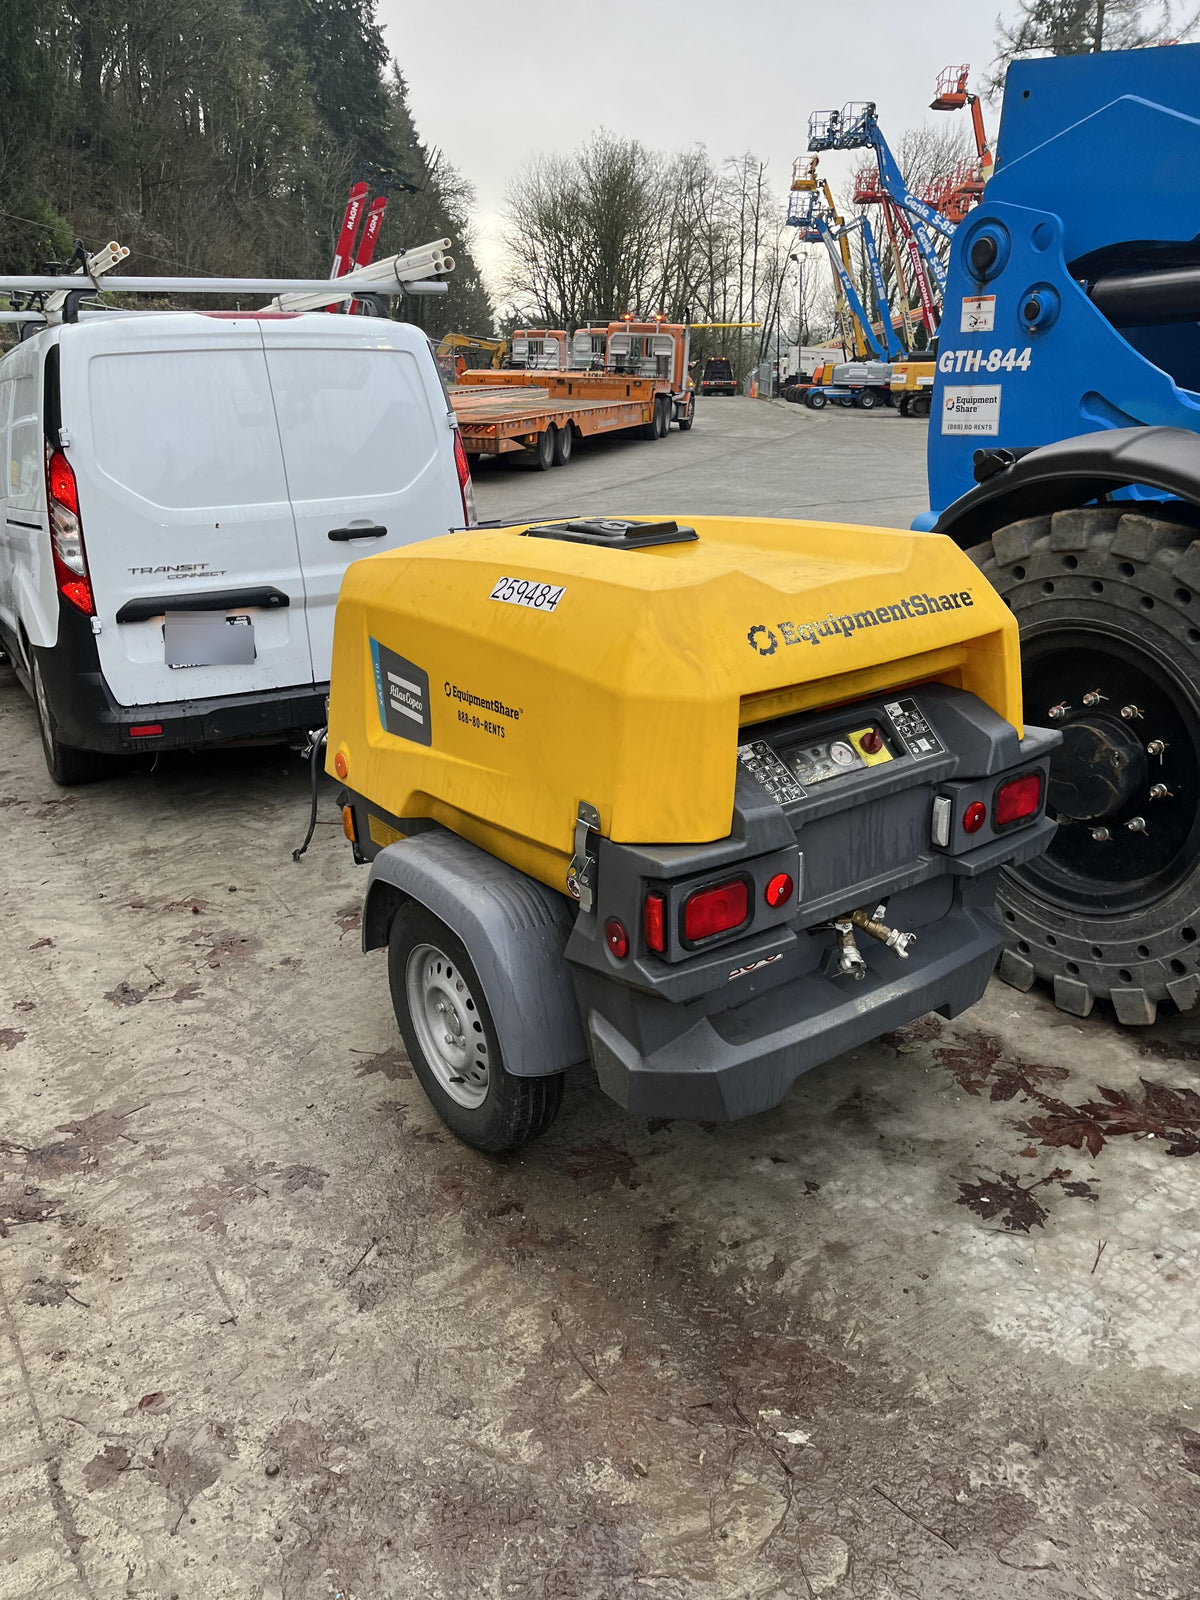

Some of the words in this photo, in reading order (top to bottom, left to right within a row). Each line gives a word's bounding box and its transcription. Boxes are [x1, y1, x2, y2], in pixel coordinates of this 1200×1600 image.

[347, 201, 360, 231] MAGNI
[367, 214, 379, 239] AGNI
[904, 195, 930, 219] Genie
[932, 213, 957, 235] S-85
[916, 226, 933, 255] Genie
[930, 256, 947, 281] S-85
[938, 347, 1032, 373] GTH-844
[955, 405, 978, 413] Share
[956, 396, 998, 406] Equipment
[127, 563, 209, 575] TRANSIT
[167, 570, 227, 580] CONNECT
[490, 577, 565, 610] 259484
[777, 590, 974, 646] EquipmentShare
[389, 684, 406, 702] Atlas
[405, 692, 423, 711] Copco
[452, 685, 520, 720] EquipmentShare
[457, 710, 506, 738] 888-80-RENTS
